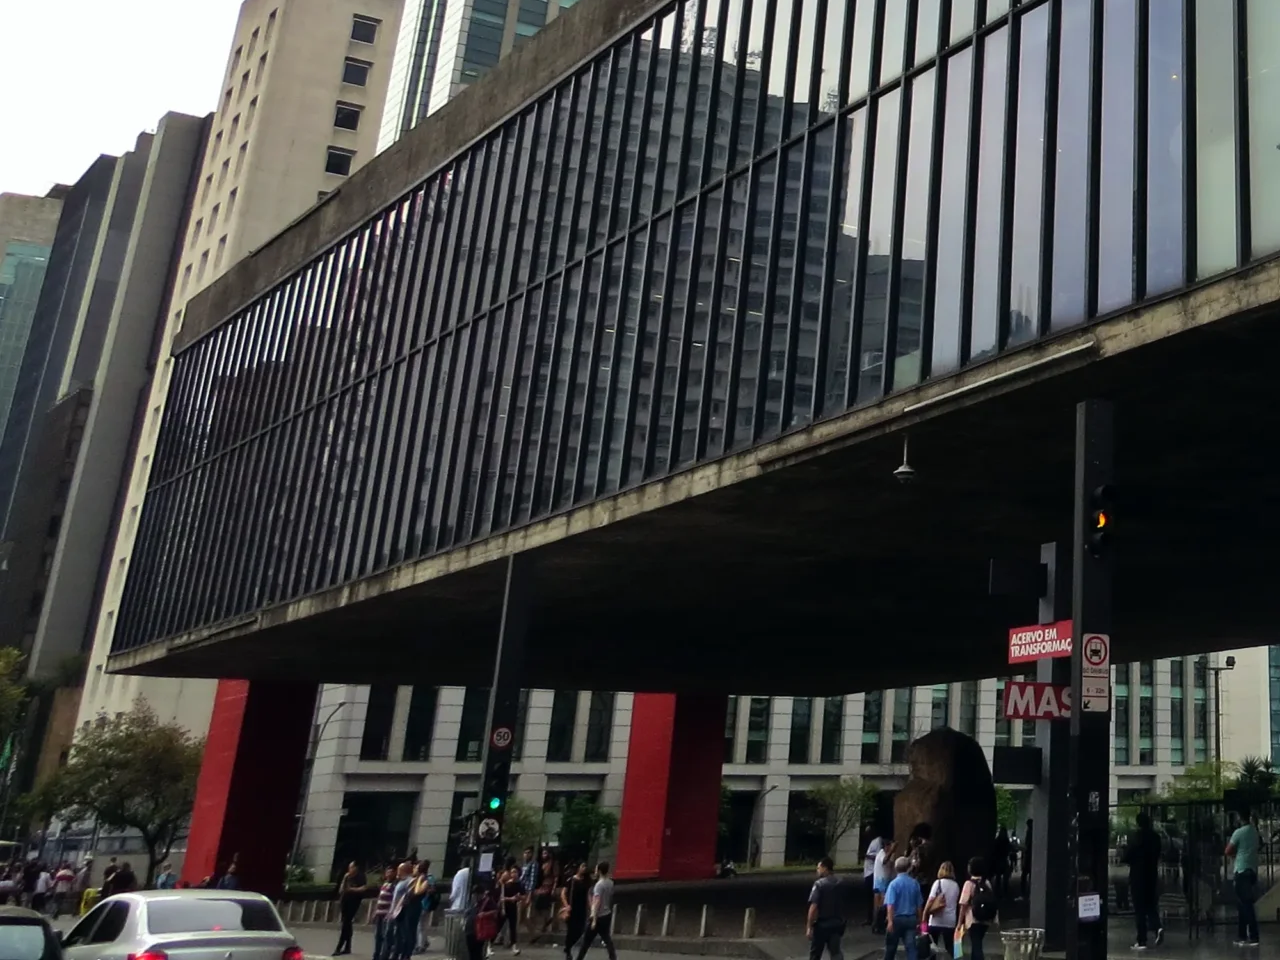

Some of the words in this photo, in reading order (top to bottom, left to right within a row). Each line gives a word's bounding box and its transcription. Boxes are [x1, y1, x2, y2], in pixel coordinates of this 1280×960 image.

[1011, 630, 1043, 645] ACERVO
[1045, 628, 1057, 639] EM
[1011, 638, 1072, 657] TRANSFORMAÇ
[1006, 685, 1072, 718] MAS
[496, 731, 509, 741] 50
